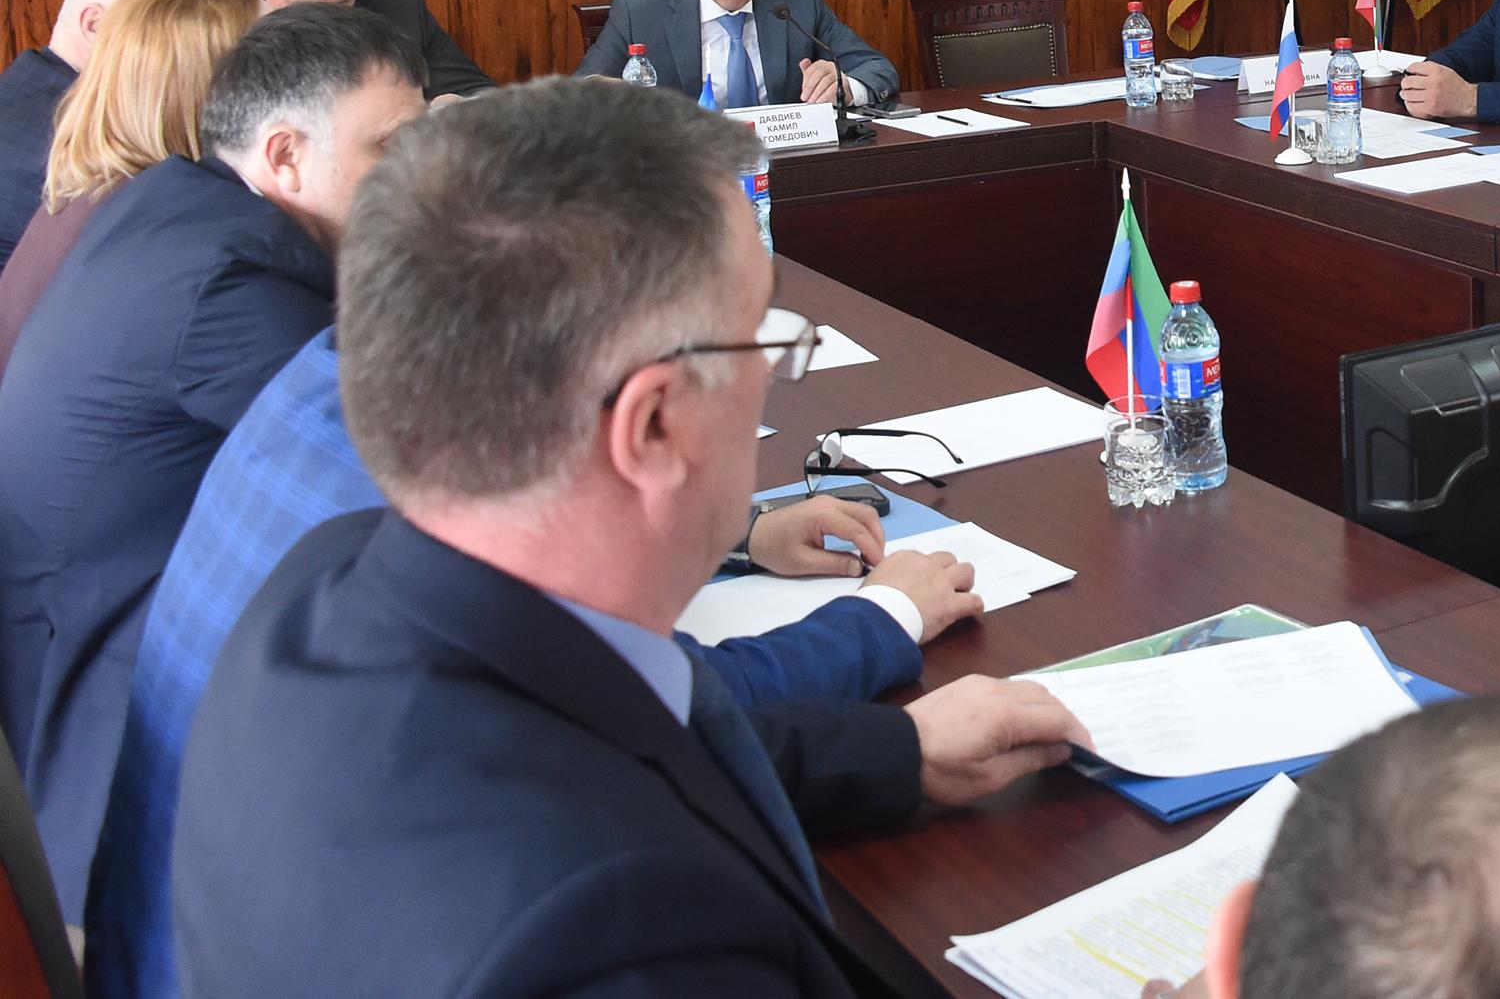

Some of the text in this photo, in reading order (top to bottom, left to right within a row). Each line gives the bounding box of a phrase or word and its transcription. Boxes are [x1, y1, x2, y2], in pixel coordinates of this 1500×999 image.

[759, 112, 802, 124] ДАВДИЕВ
[767, 122, 798, 133] КАМИЛ
[760, 130, 819, 143] ГОМЕДОВИЧ
